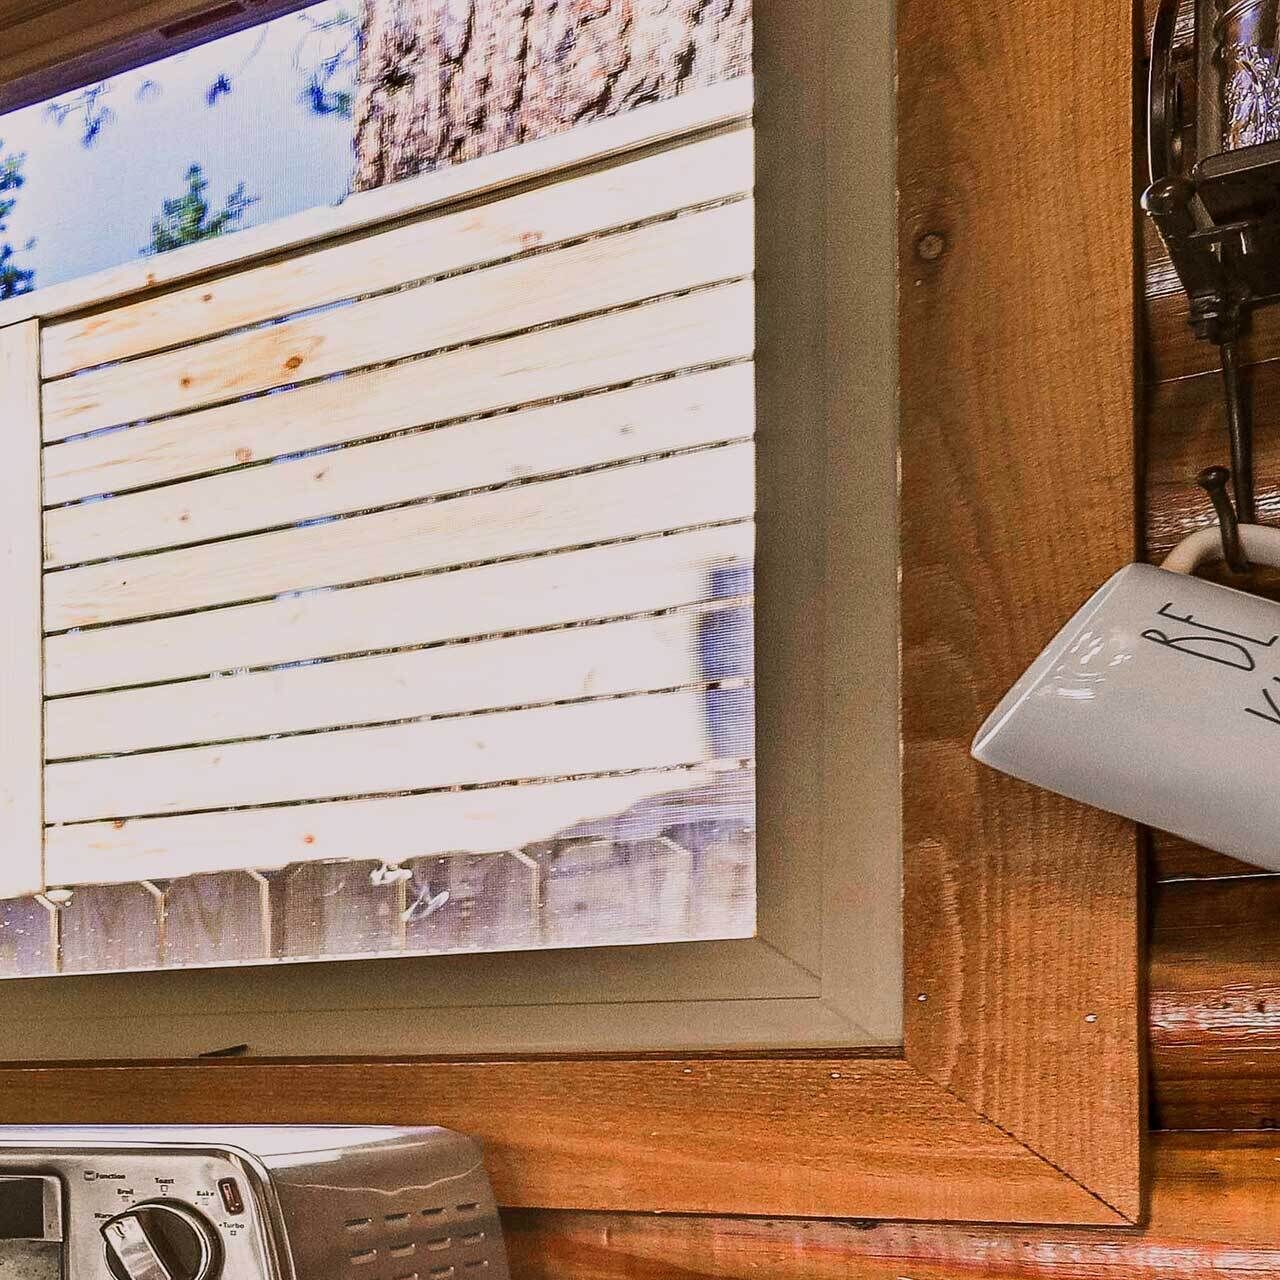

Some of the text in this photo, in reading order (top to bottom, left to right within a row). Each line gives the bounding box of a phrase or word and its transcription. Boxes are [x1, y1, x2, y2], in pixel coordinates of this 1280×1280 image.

[1141, 602, 1279, 672] BE
[95, 1172, 126, 1180] Function
[154, 1177, 175, 1185] Toast
